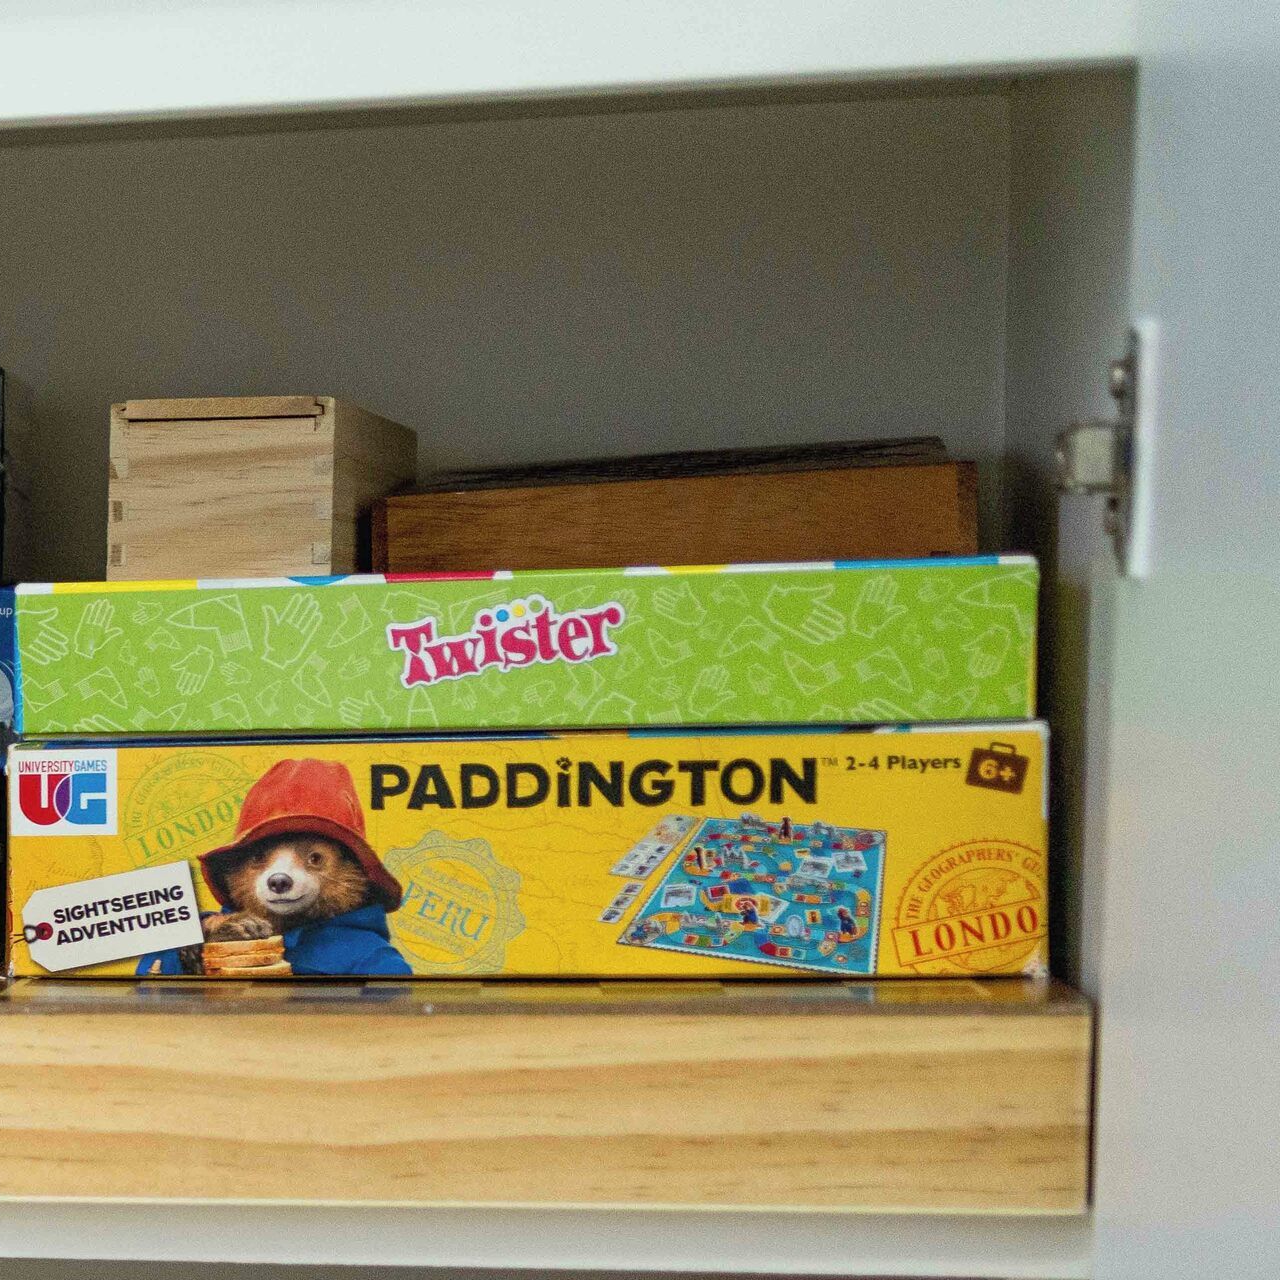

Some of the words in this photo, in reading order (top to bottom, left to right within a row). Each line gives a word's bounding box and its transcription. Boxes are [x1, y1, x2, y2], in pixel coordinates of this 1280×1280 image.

[390, 606, 622, 686] Twister
[845, 755, 880, 771] 2-4
[886, 754, 962, 774] Players
[978, 759, 1017, 781] 6+
[53, 885, 185, 925] SIGHTSEEING
[56, 905, 191, 946] ADVENTURES
